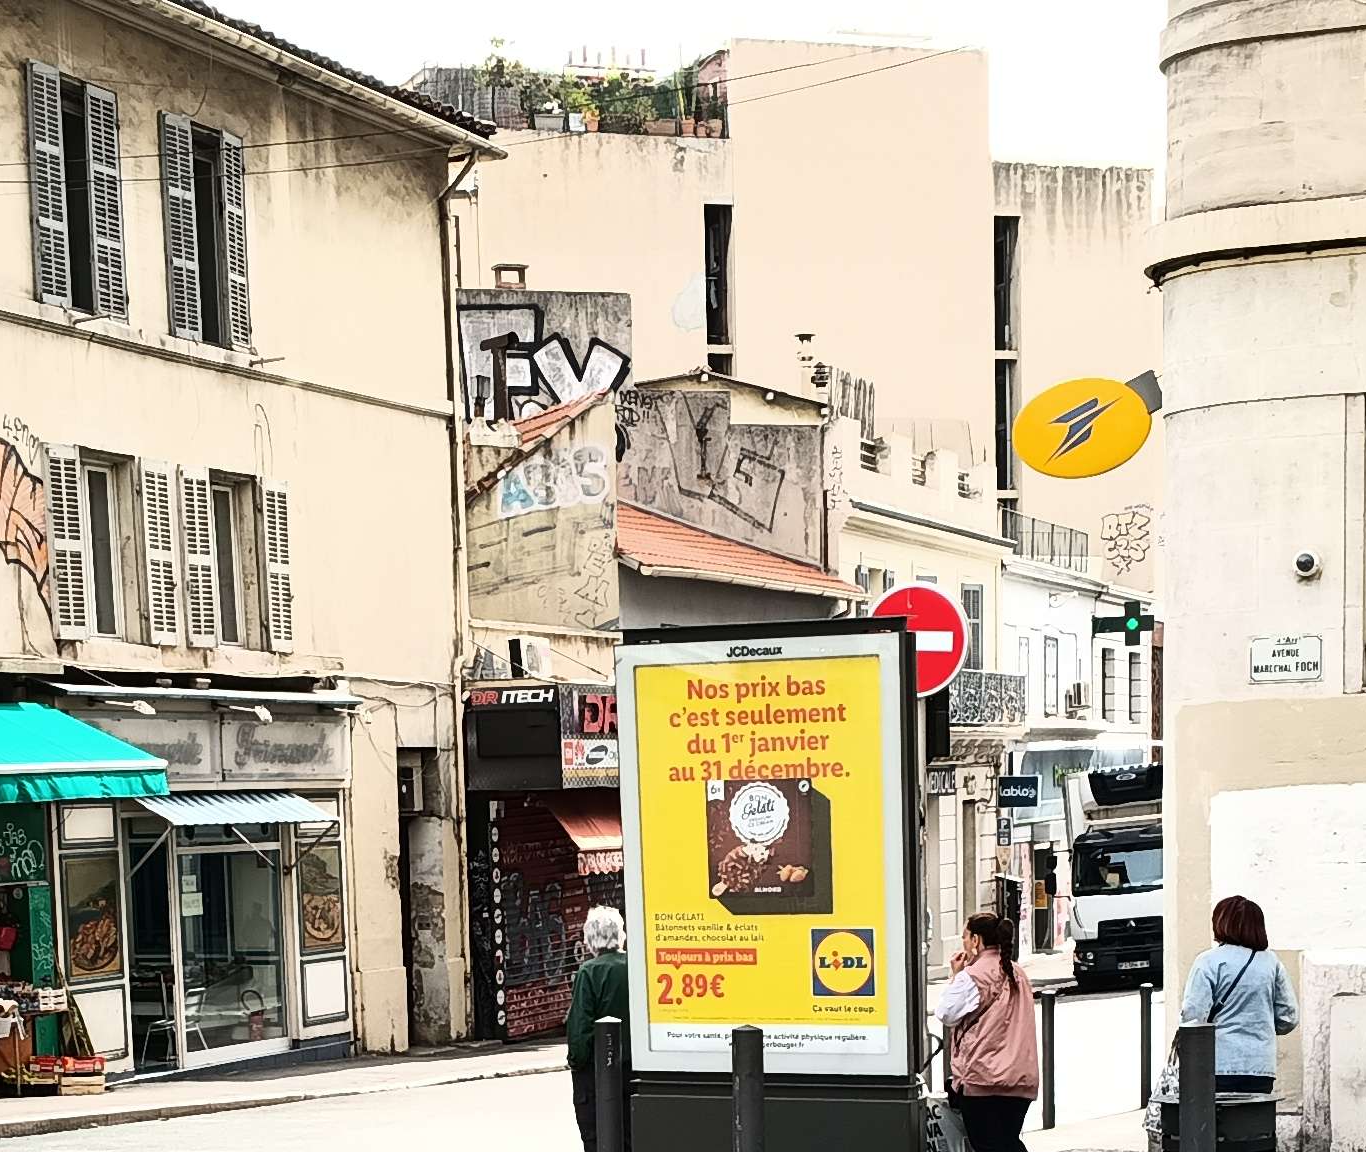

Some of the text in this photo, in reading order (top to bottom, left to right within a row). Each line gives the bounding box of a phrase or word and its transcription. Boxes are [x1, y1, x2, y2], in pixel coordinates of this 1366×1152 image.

[726, 645, 783, 658] JCDecaux
[1271, 648, 1300, 658] AVENUE
[1295, 660, 1319, 673] FOCH
[687, 674, 826, 704] Nos prix bas
[471, 691, 498, 706] DR
[669, 703, 847, 728] c'est seulement
[687, 729, 830, 758] du 1er janvier
[669, 756, 851, 782] au 31 décembre.
[655, 913, 673, 921] BON
[702, 933, 737, 942] chocolat
[658, 951, 703, 964] Toujours
[712, 951, 735, 964] prix
[735, 951, 754, 962] bas
